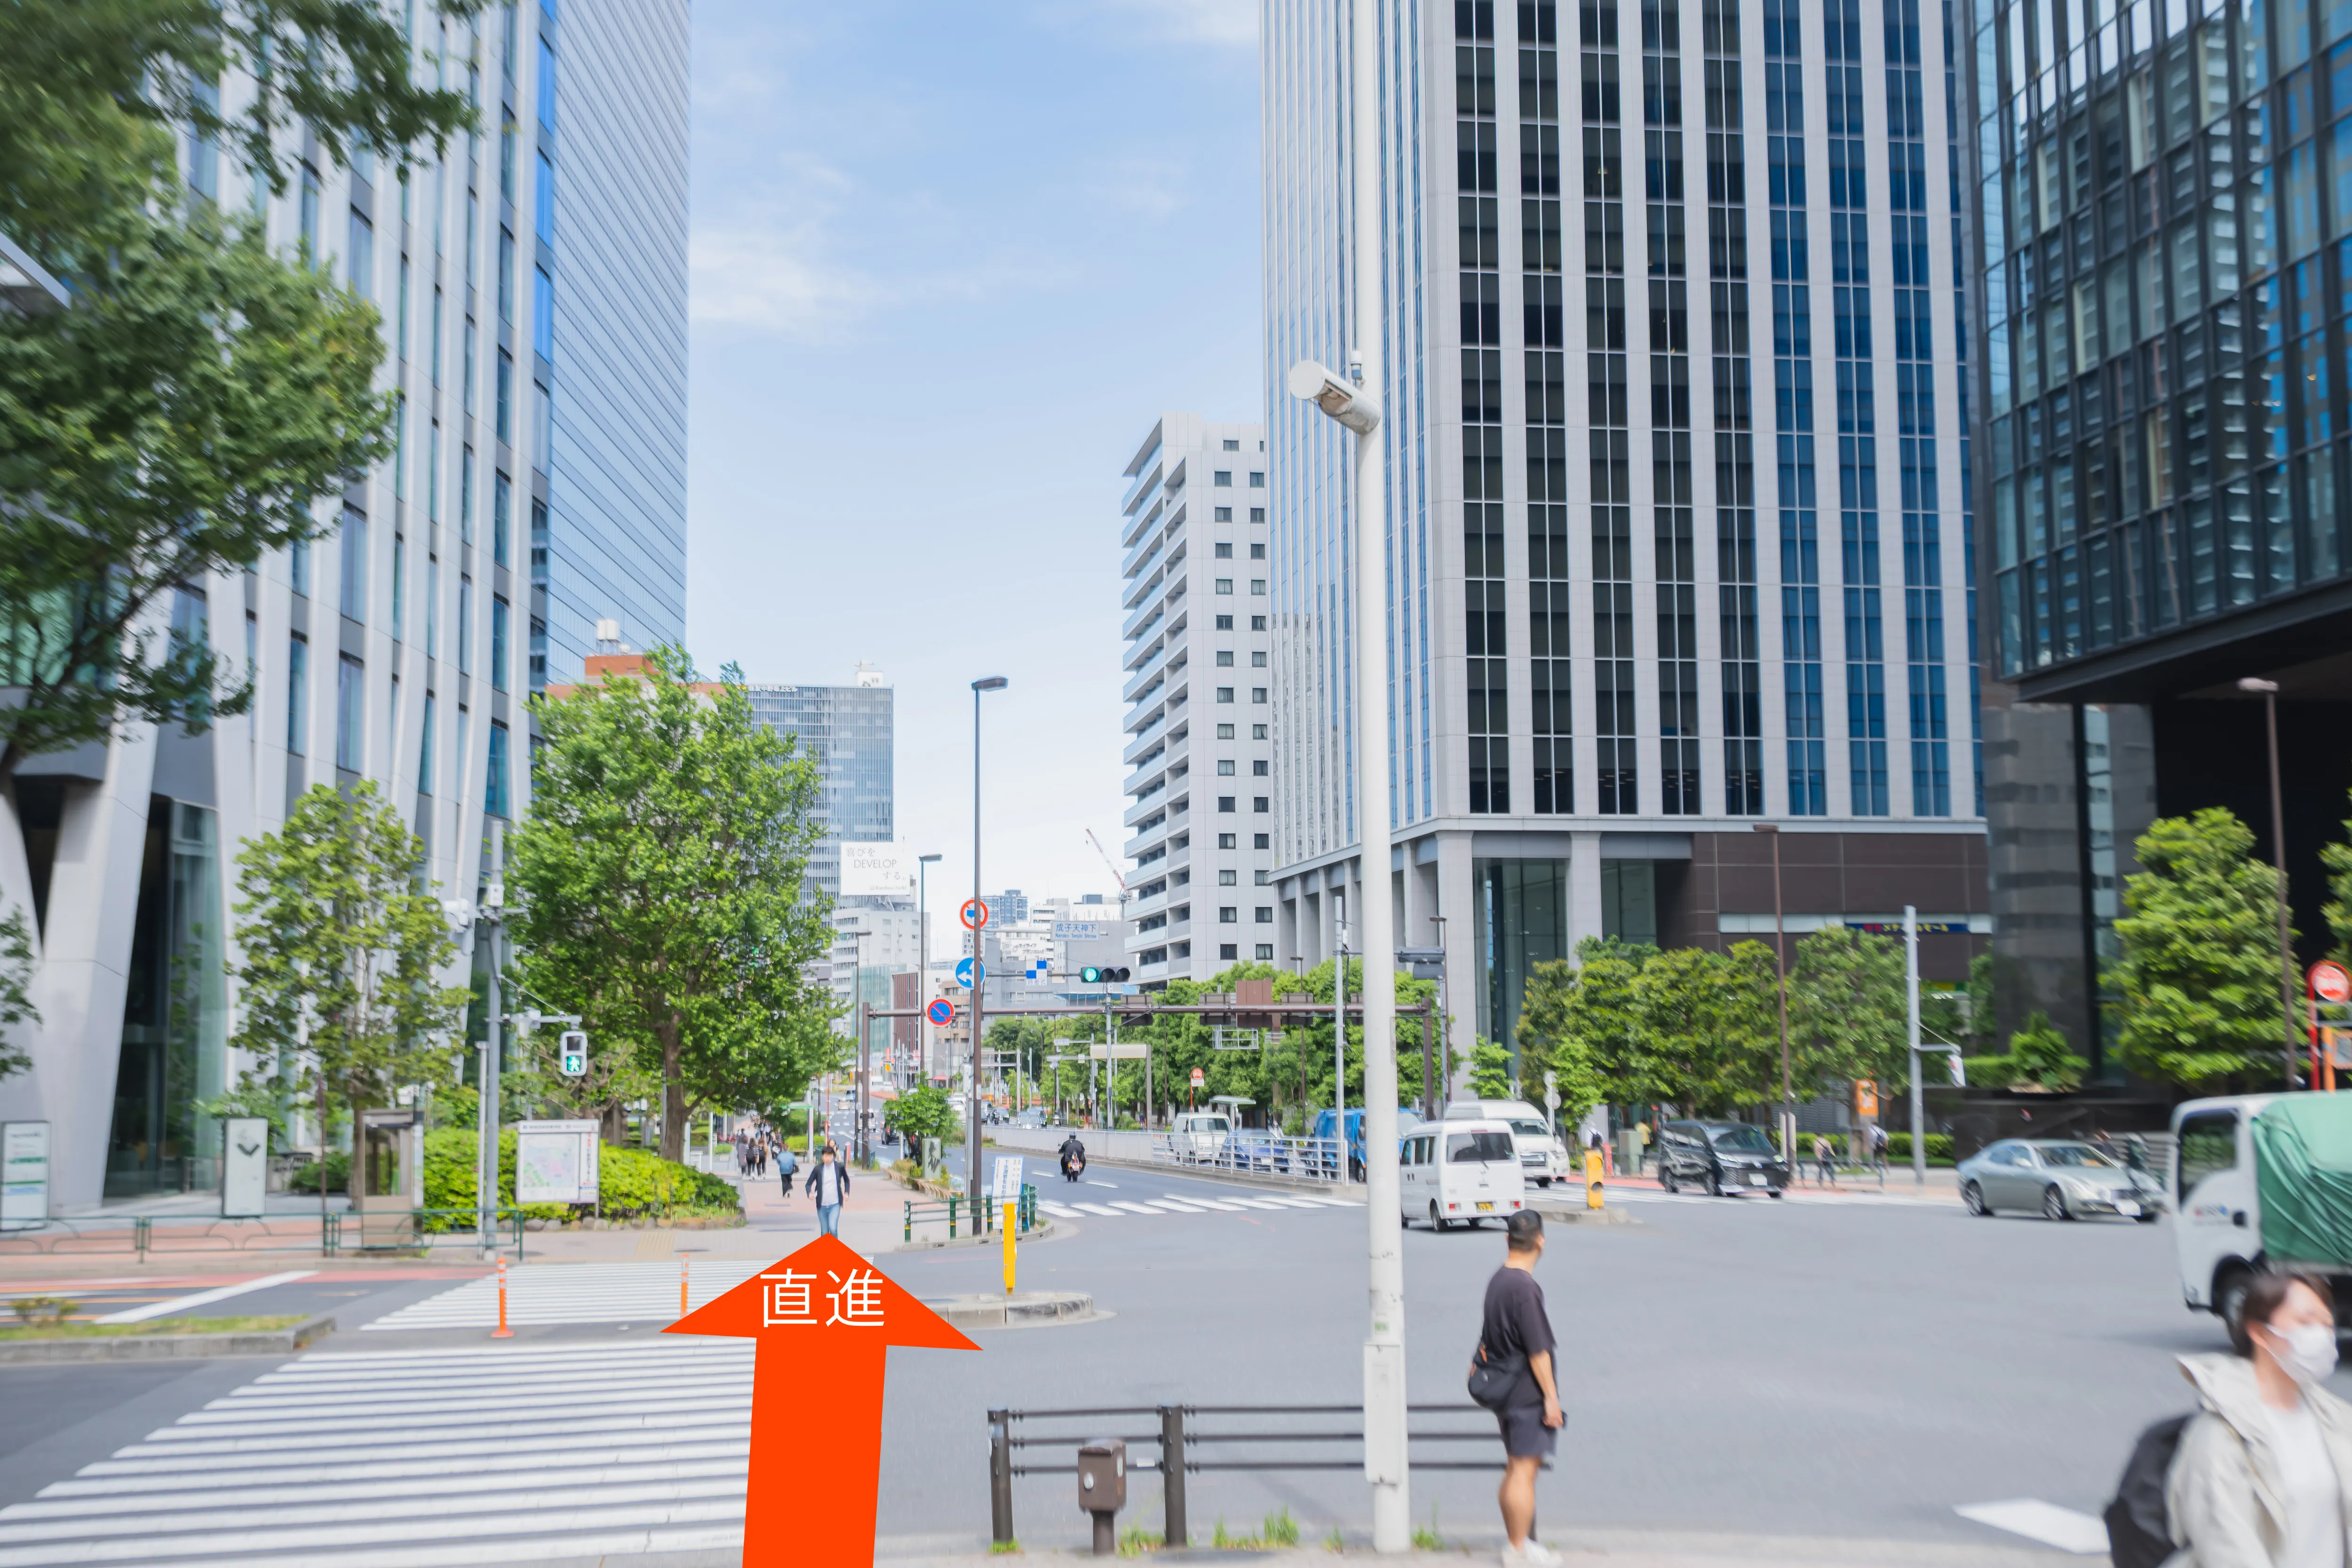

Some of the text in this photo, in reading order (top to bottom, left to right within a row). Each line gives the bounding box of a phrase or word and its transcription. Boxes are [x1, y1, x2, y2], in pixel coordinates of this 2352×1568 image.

[847, 848, 875, 857] 喜びを
[854, 859, 897, 868] DEVELOP
[1056, 923, 1097, 932] 成子天神下
